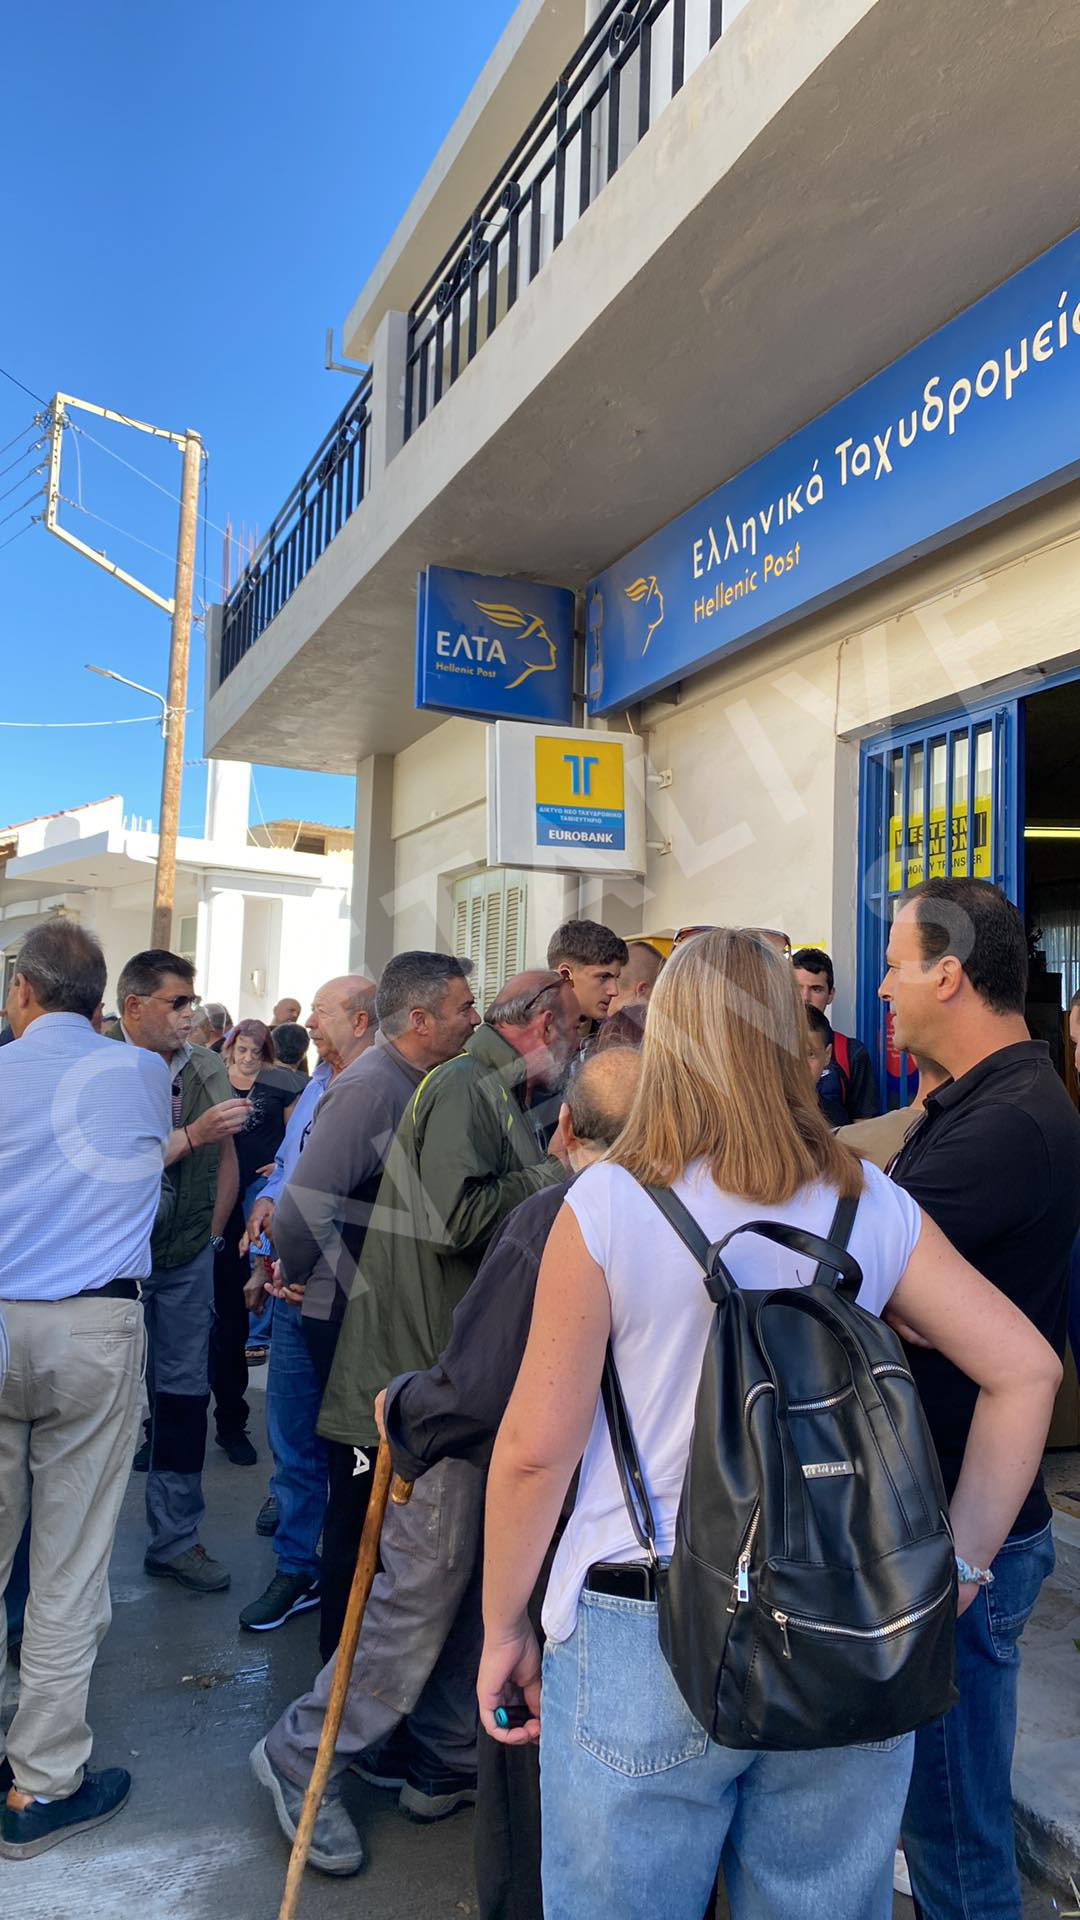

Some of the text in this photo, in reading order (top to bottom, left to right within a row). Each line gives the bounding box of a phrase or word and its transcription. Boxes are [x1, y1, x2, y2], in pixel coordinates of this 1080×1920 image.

[692, 459, 824, 579] Ελληνικά
[693, 542, 801, 624] Hellenic Post
[436, 630, 507, 665] ΕΛΤΑ
[435, 661, 497, 678] Hellenic Post
[548, 829, 614, 844] EUROBANK
[905, 862, 935, 875] ONY
